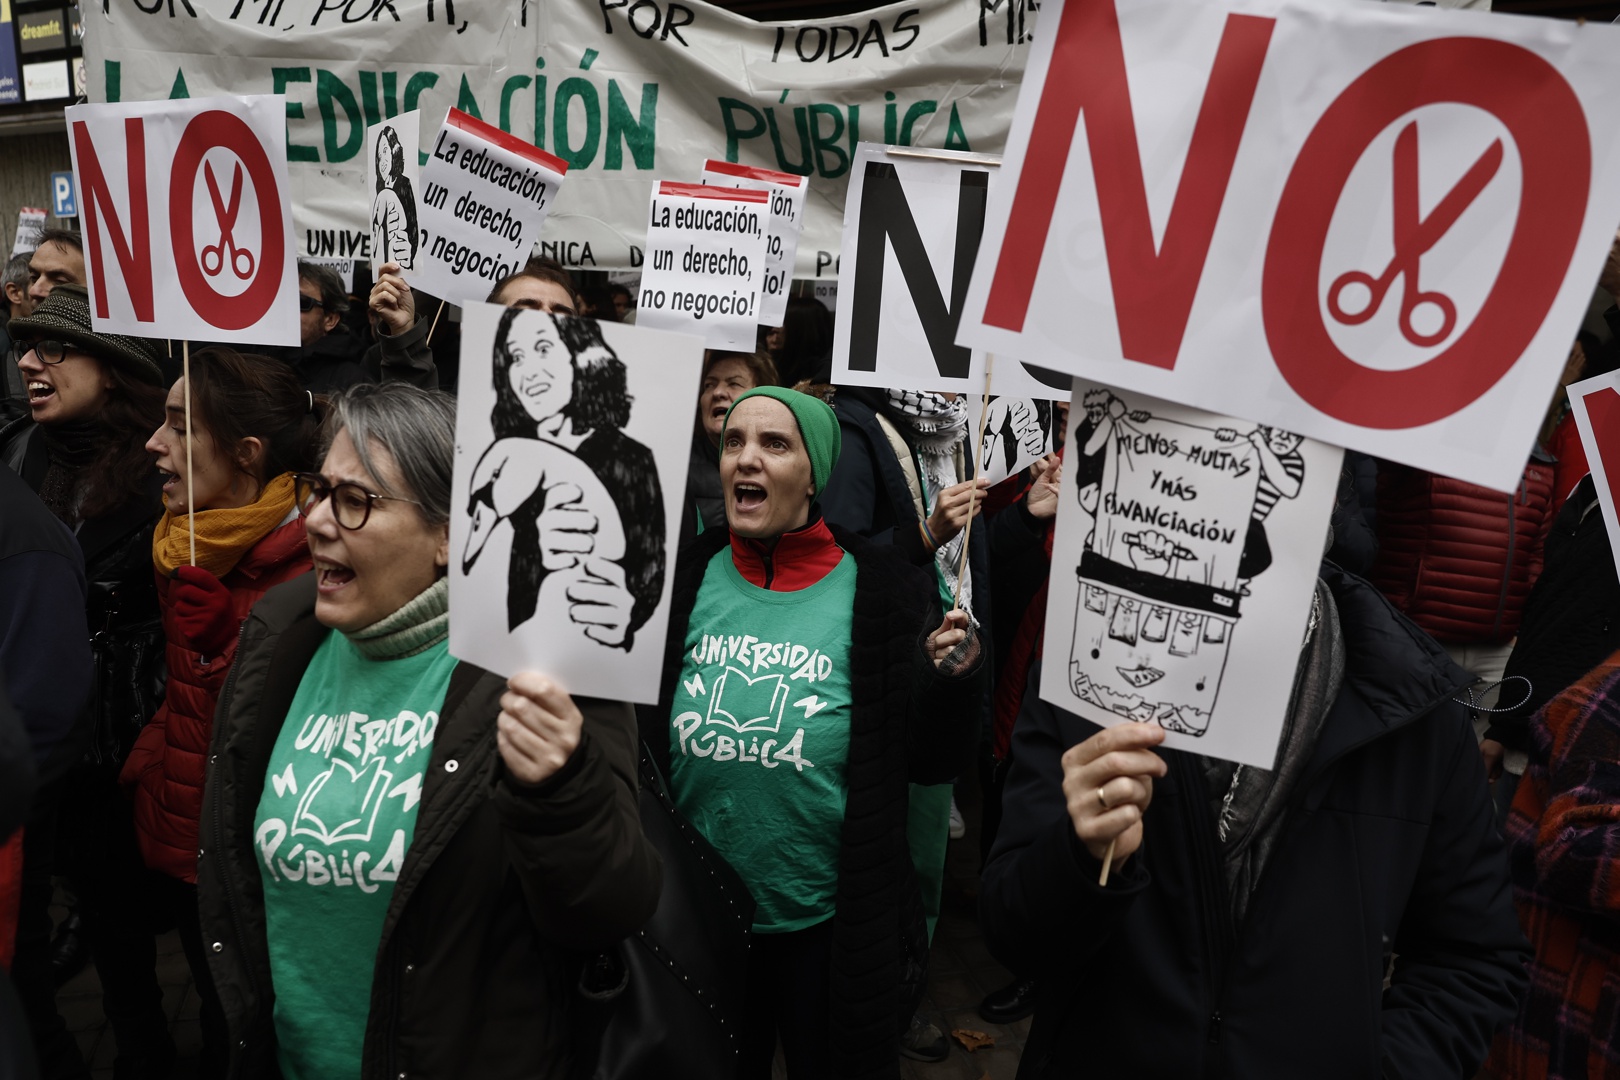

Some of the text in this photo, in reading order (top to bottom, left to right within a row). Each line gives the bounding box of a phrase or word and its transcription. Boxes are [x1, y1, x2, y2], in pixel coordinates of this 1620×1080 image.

[311, 0, 401, 26] POR
[600, 0, 695, 47] POR
[771, 8, 920, 63] TODAS
[55, 177, 70, 212] P
[434, 130, 546, 210] La educación,
[72, 109, 284, 331] NO
[423, 182, 448, 210] un
[454, 191, 523, 249] derecho,
[651, 200, 761, 240] La educación,
[981, 0, 1592, 430] NO
[430, 235, 519, 283] negocio!
[530, 240, 596, 267] NICA
[816, 250, 840, 277] P
[653, 245, 751, 281] un derecho,
[848, 161, 1072, 391] N
[641, 289, 755, 320] no negocio!
[1117, 433, 1251, 478] MENOS MULTAS
[1161, 476, 1197, 501] MÁS
[1105, 492, 1236, 544] FINANCIACIÓN
[691, 634, 833, 683] UNIVERSIDAD
[295, 711, 440, 766] UNIVERSDD
[673, 711, 815, 772] PÚBLICA
[255, 817, 406, 894] PÚBLICA
